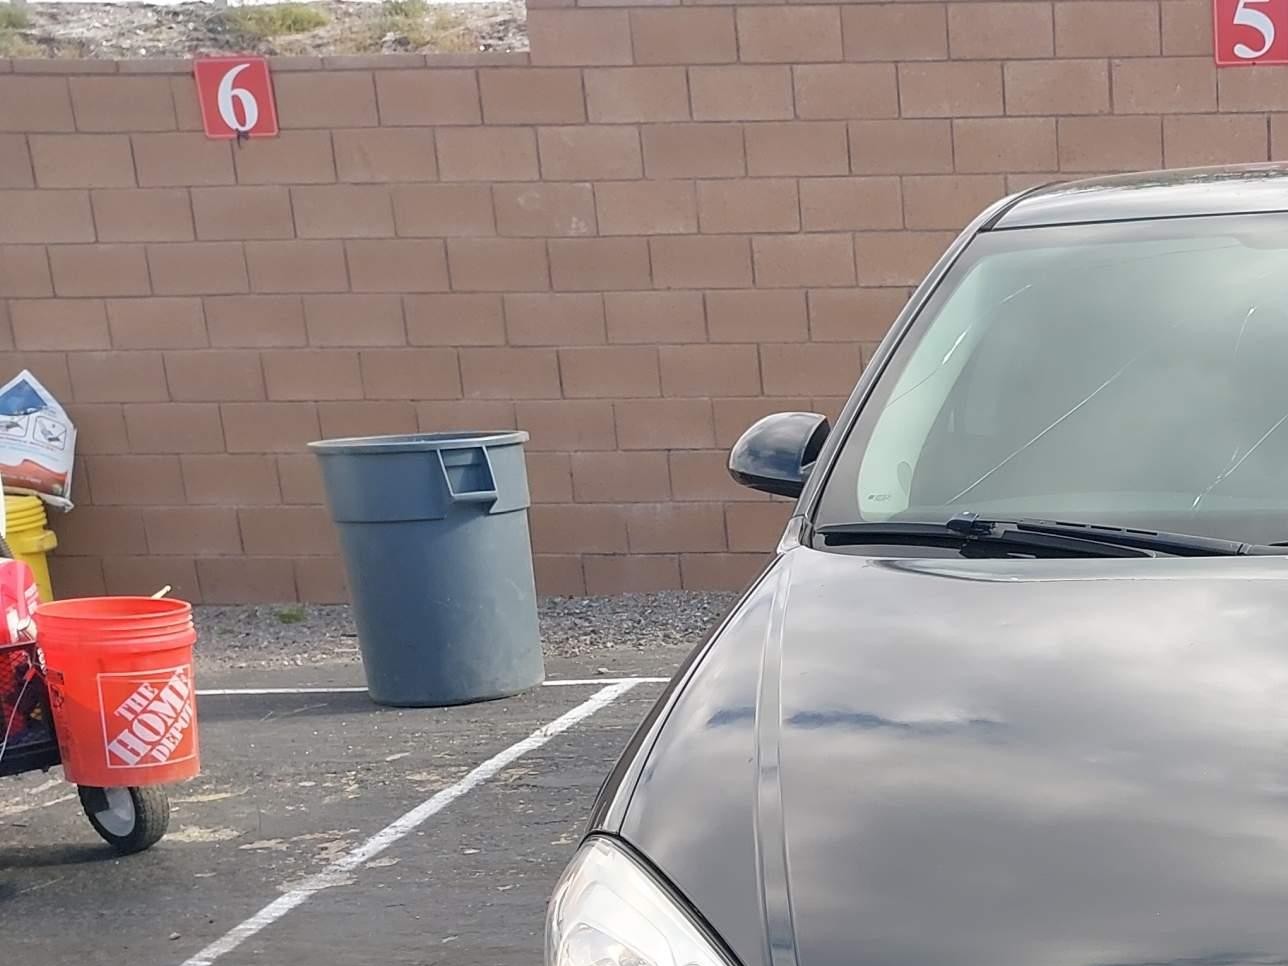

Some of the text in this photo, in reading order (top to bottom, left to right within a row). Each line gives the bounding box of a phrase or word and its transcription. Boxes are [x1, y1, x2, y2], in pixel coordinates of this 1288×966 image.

[1232, 0, 1275, 59] 5
[217, 63, 259, 132] 6
[108, 667, 190, 766] HOME
[113, 682, 159, 721] THE
